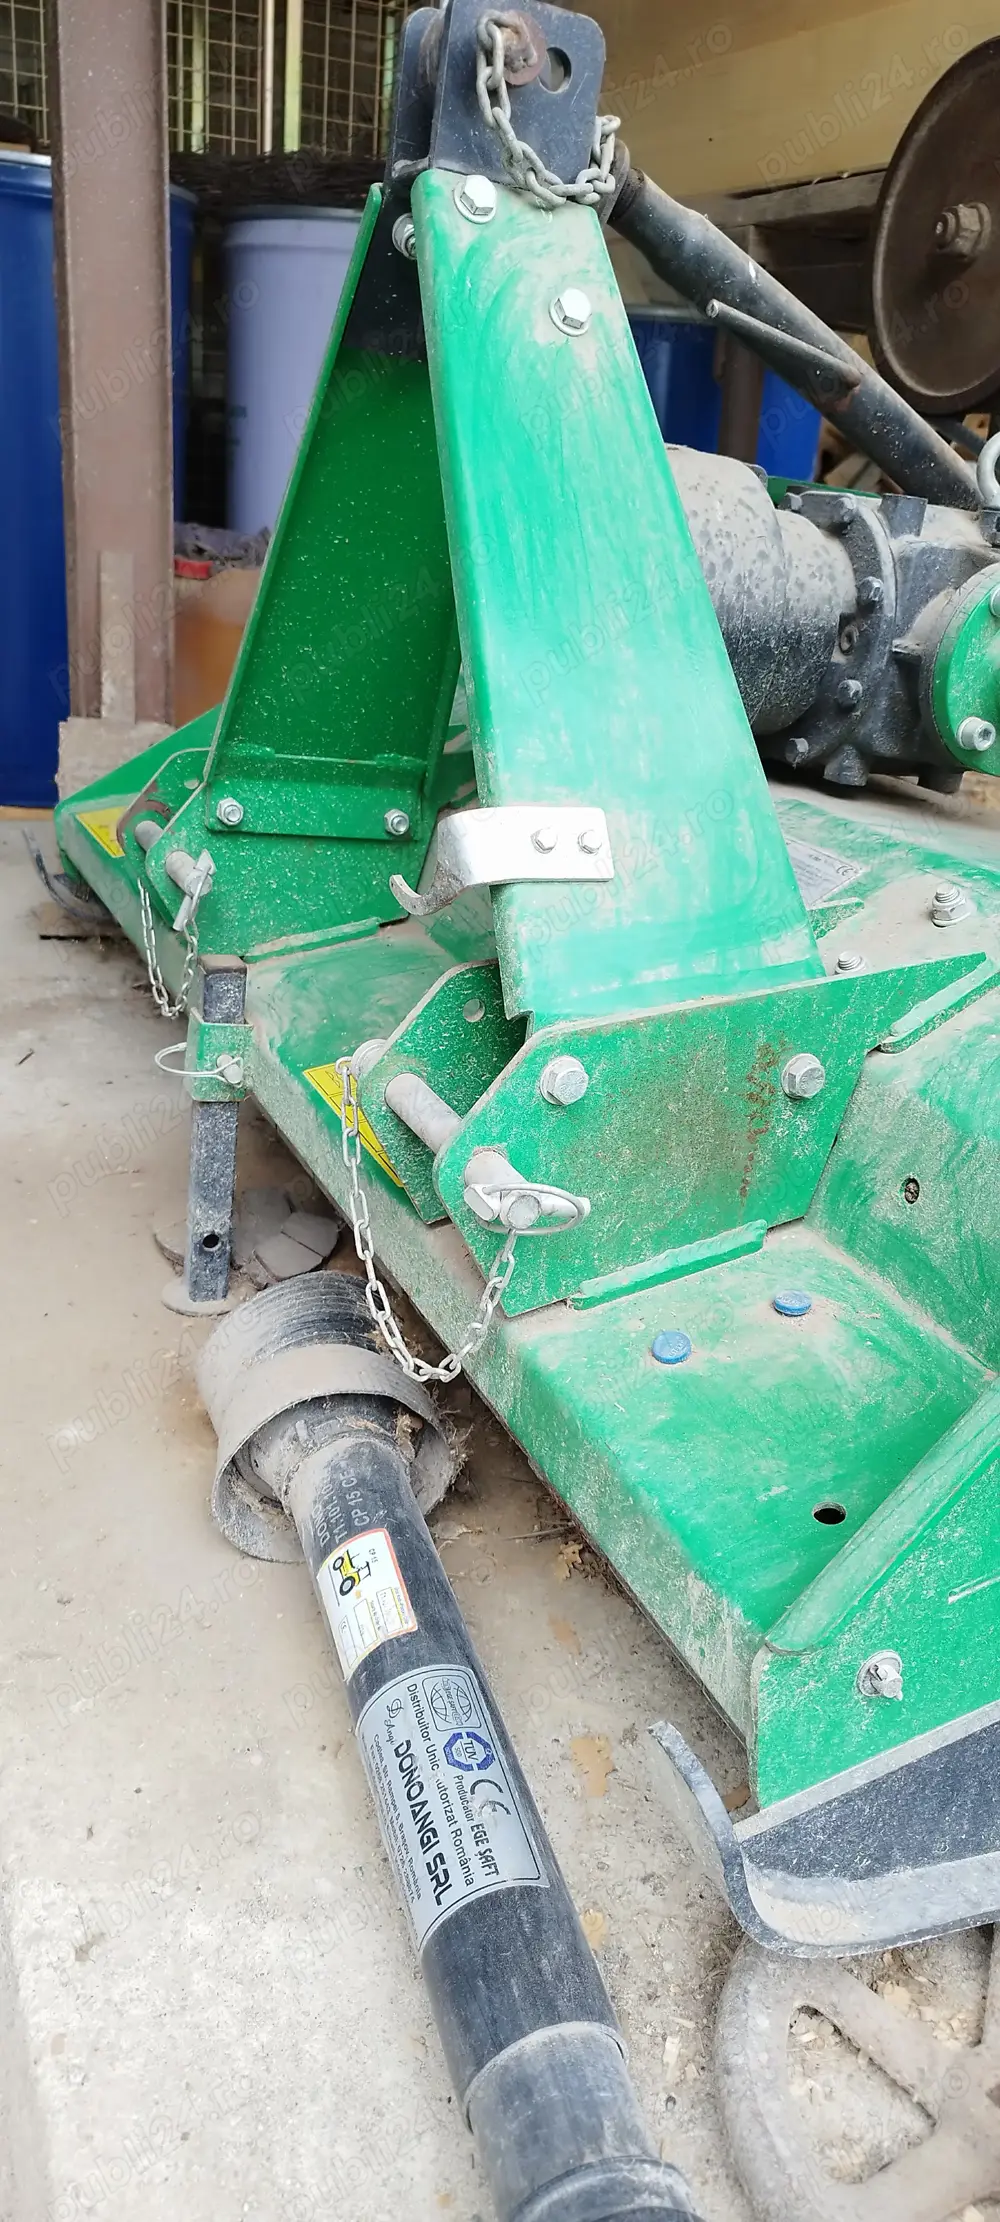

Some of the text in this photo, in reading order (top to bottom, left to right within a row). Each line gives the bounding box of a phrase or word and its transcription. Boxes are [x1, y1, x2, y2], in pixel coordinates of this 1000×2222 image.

[352, 1508, 370, 1527] CP
[462, 1738, 478, 1760] TÜV
[405, 1683, 432, 1744] Distribuitor
[423, 1744, 441, 1771] Unic
[434, 1777, 458, 1827] utorizat
[449, 1829, 475, 1886] România
[392, 1739, 454, 1906] DONOANGI SRL
[469, 1821, 489, 1847] EGE
